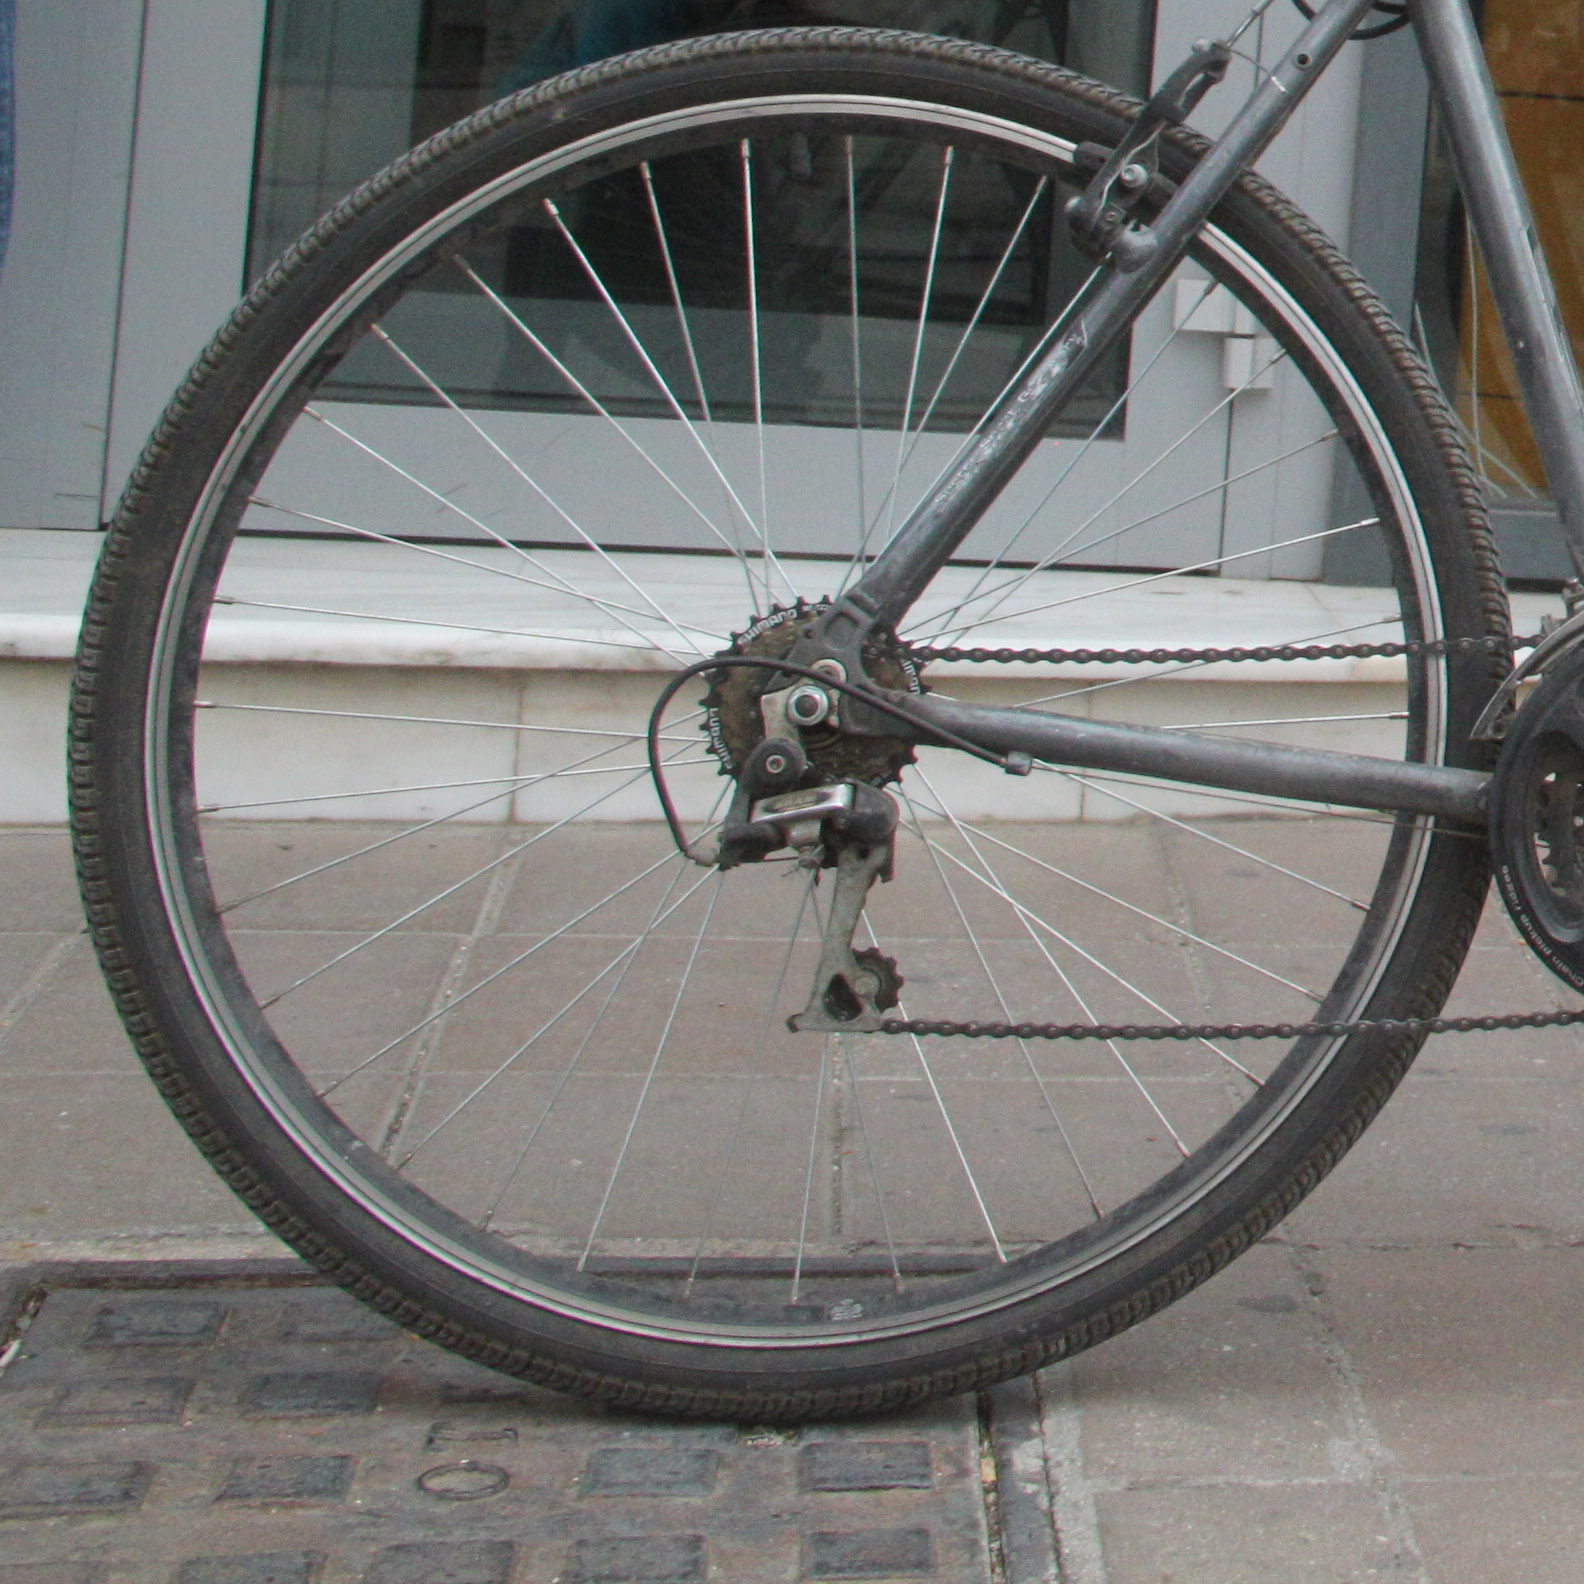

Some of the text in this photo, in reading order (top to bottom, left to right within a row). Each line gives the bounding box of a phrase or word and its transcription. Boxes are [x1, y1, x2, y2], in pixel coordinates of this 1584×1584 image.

[738, 607, 798, 646] SHIMANO
[1520, 913, 1553, 955] pickup
[1552, 955, 1584, 987] Chain
